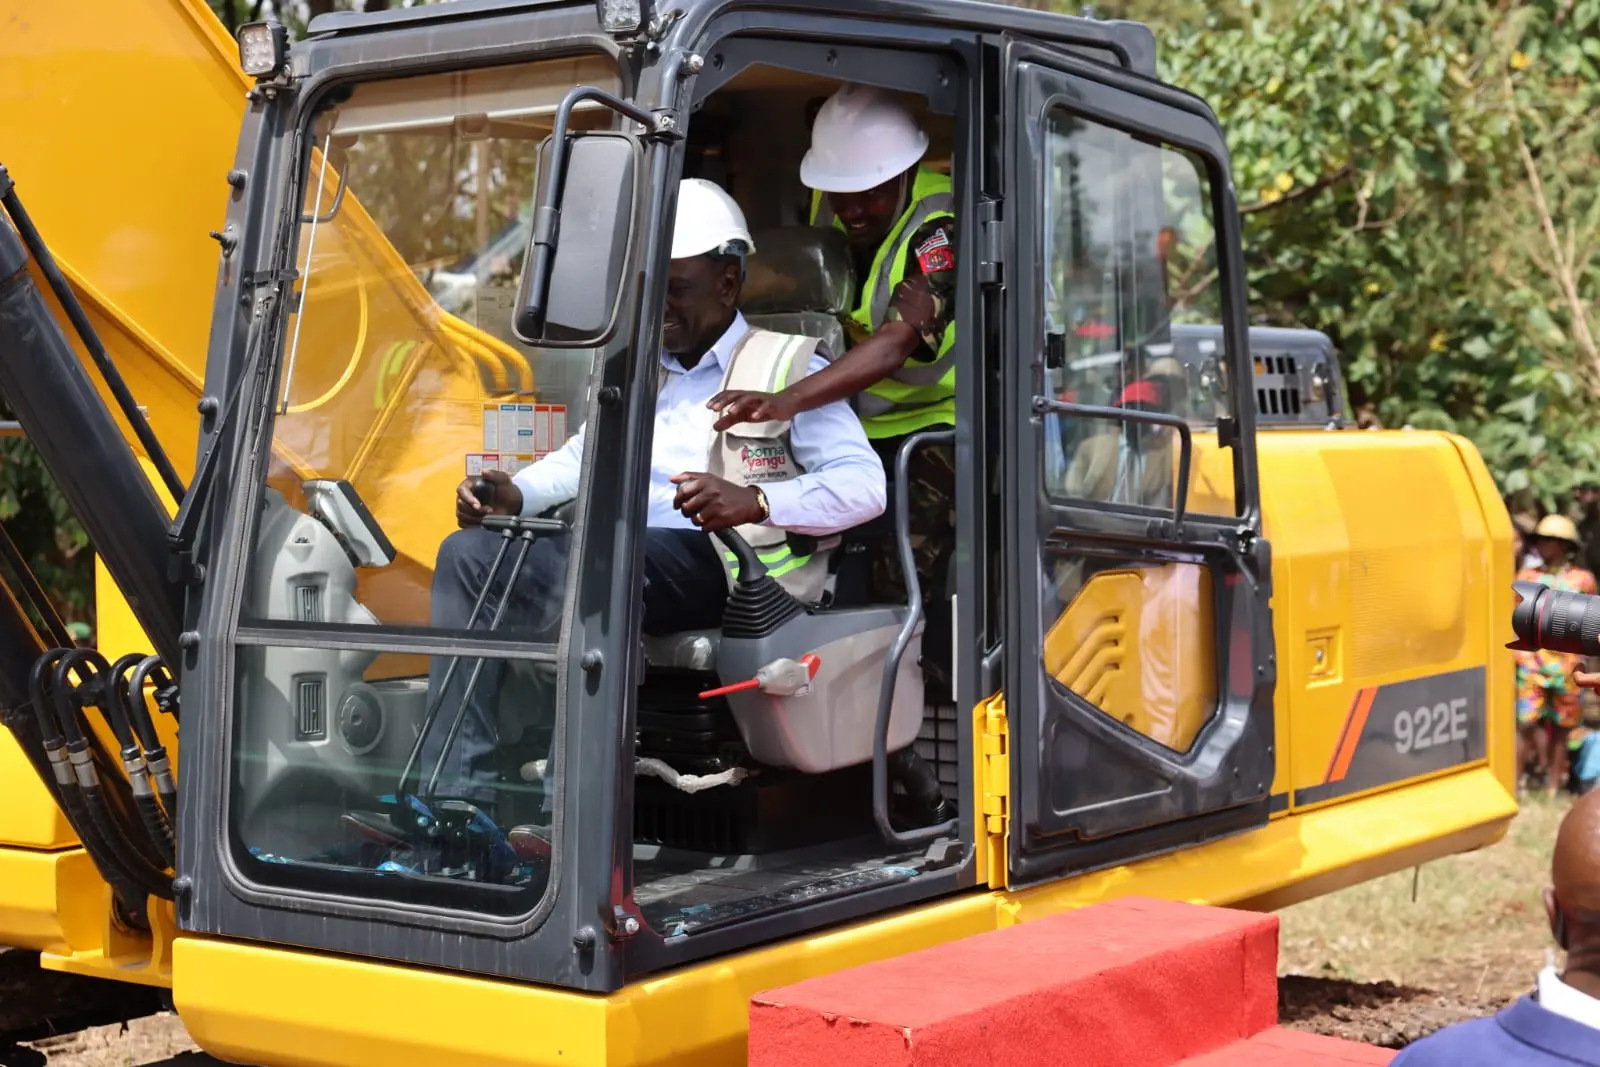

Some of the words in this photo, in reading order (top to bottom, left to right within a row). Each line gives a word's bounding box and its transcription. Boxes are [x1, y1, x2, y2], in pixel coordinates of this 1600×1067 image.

[747, 446, 785, 458] boma
[747, 456, 786, 470] yangu
[1394, 697, 1468, 754] 922E
